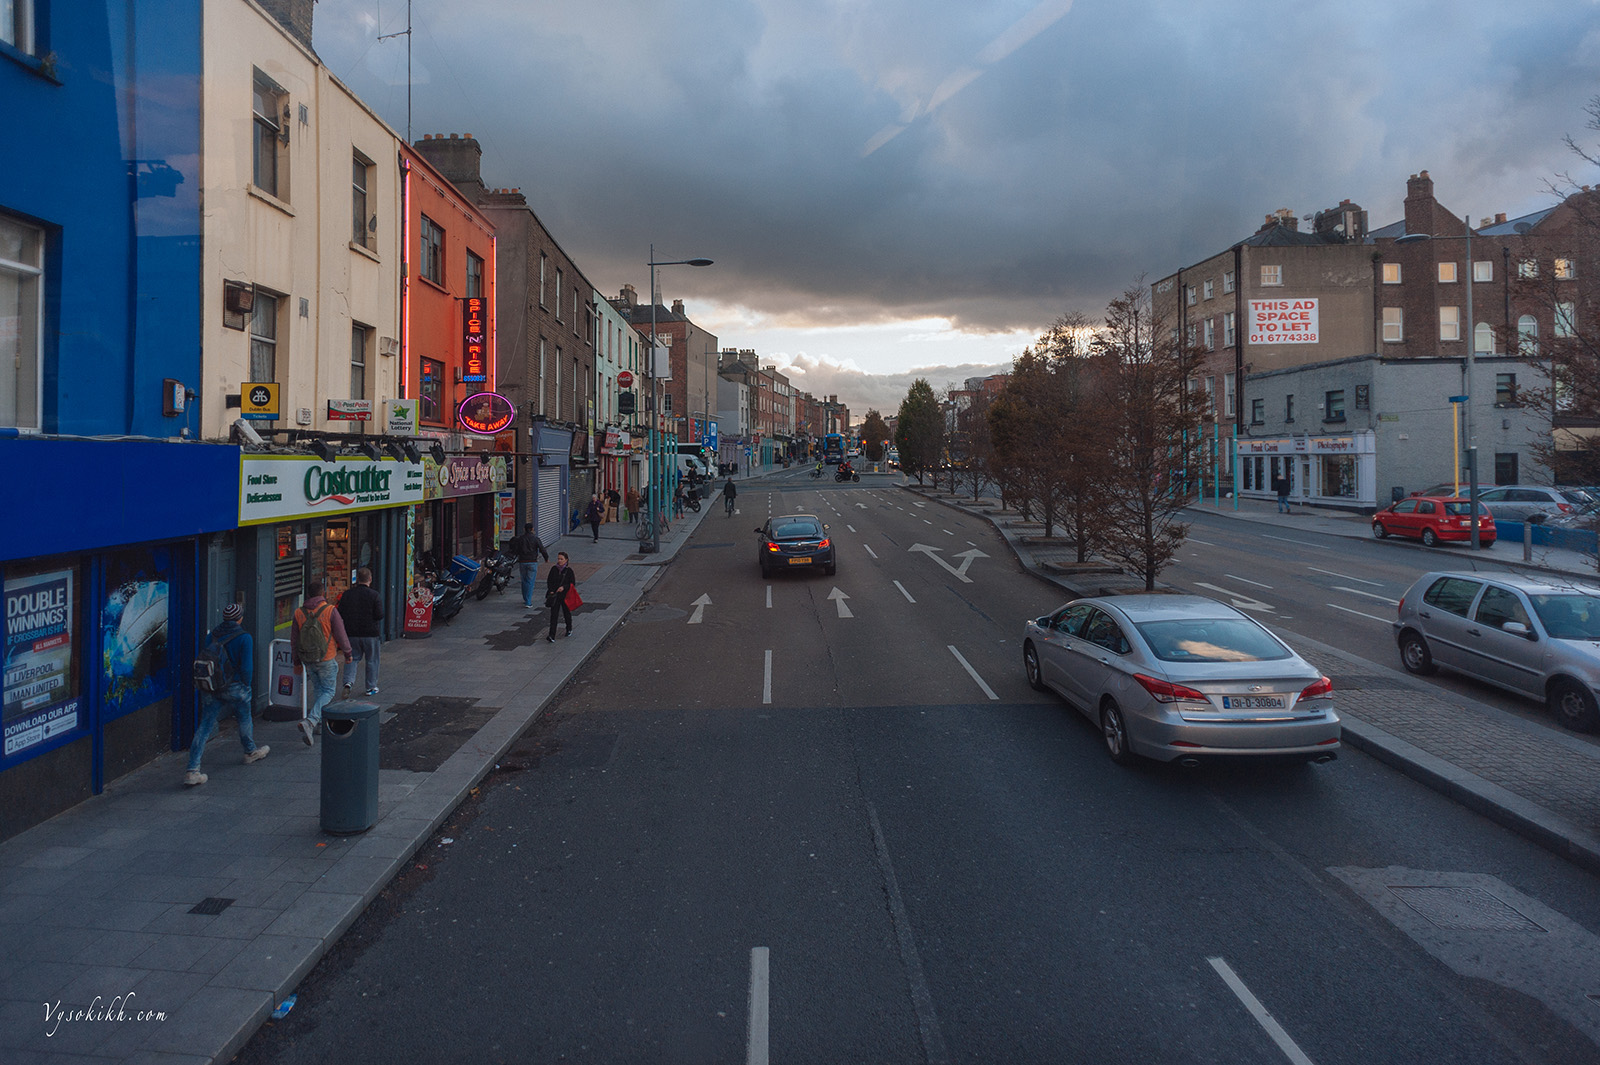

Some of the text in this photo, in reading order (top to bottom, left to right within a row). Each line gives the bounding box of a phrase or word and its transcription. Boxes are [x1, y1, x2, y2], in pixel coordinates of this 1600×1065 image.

[468, 298, 481, 333] SPICE
[1251, 301, 1315, 311] THIS AD
[1256, 312, 1310, 321] SPACE
[1251, 333, 1317, 342] 01 6774338
[1256, 322, 1312, 332] TO LET
[468, 345, 481, 374] RICE
[465, 414, 508, 431] TAKE AWAY
[247, 474, 278, 485] Food Store
[304, 465, 392, 501] Costcutter
[450, 461, 469, 488] Spice
[246, 492, 282, 504] Delicatessen
[357, 492, 390, 503] Proud to be local
[7, 587, 65, 618] DOUBLE
[7, 608, 64, 635] WINNINGS
[7, 623, 64, 646] IF CROSSBAR IS HIT
[14, 663, 55, 683] LIVERPOOL
[12, 687, 31, 701] MAN
[32, 679, 59, 695] UNITED
[4, 713, 47, 737] DOWNLOAD
[47, 707, 63, 719] OUR
[64, 702, 78, 713] APP
